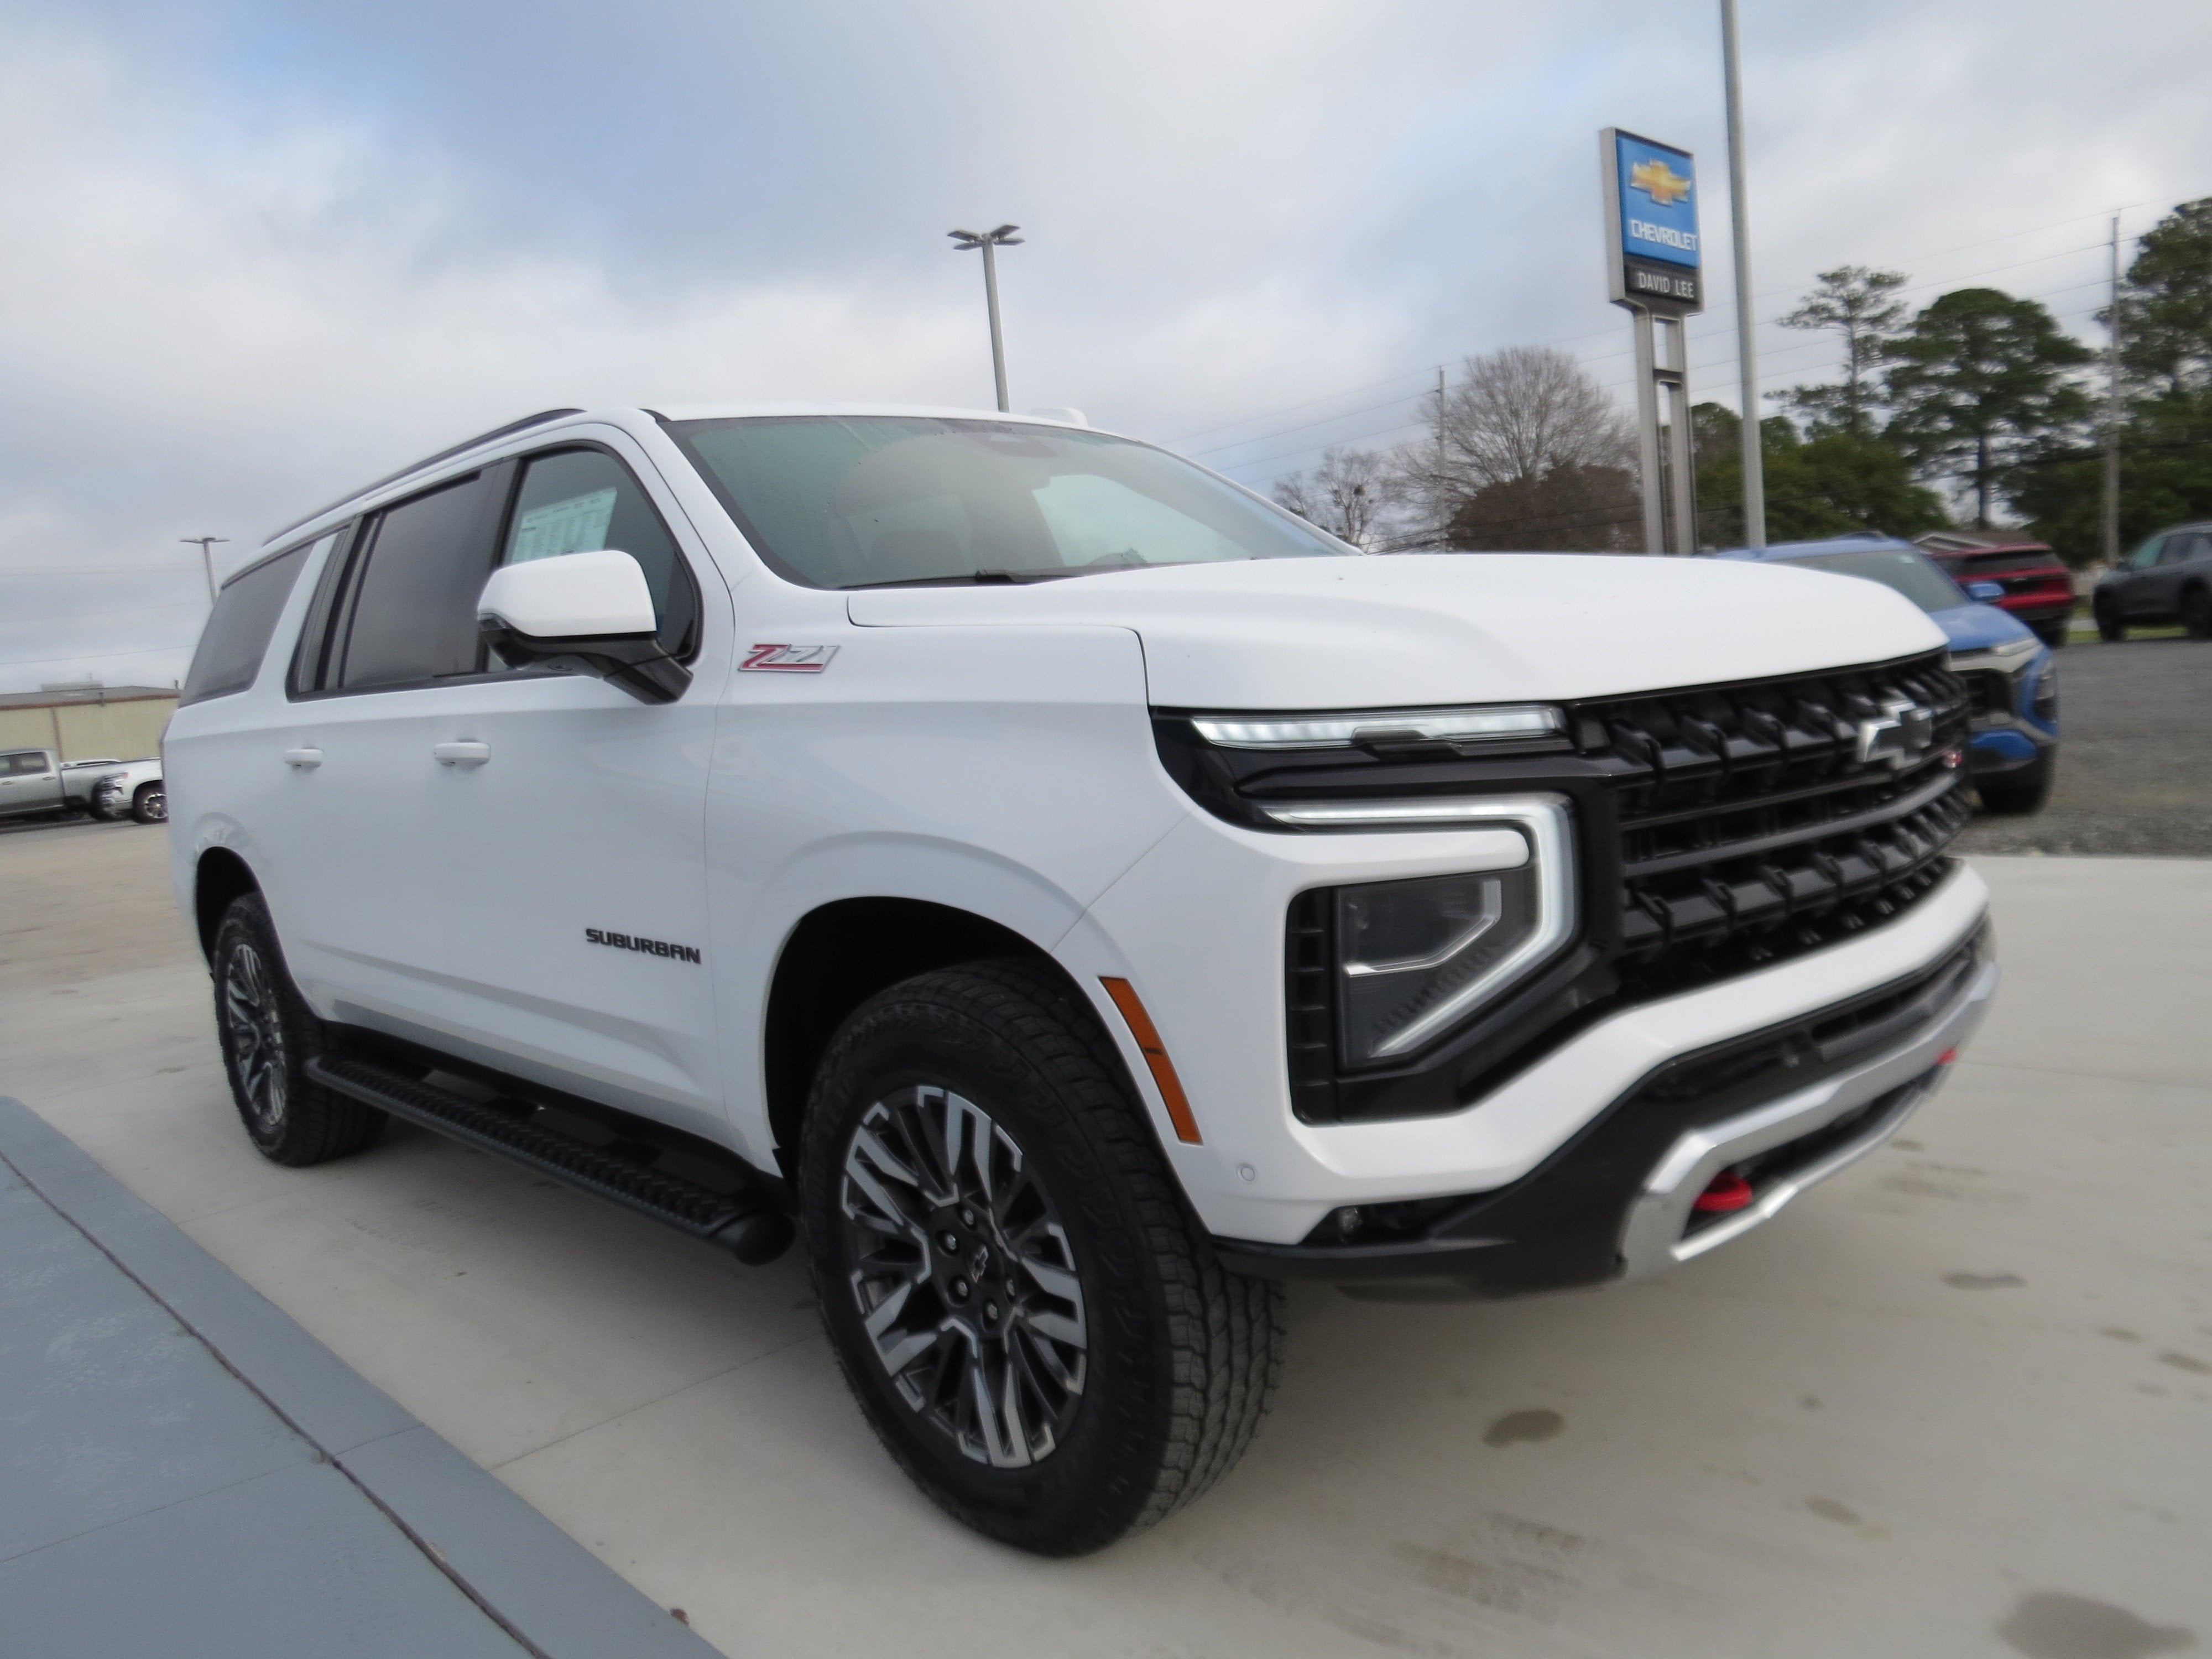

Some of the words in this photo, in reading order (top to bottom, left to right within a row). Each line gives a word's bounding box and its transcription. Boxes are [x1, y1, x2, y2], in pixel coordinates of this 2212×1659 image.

[1630, 220, 1698, 251] CHEVROLET
[1638, 271, 1671, 294] DAVID
[1676, 280, 1694, 299] LEE
[585, 928, 701, 964] SUBURBAN
